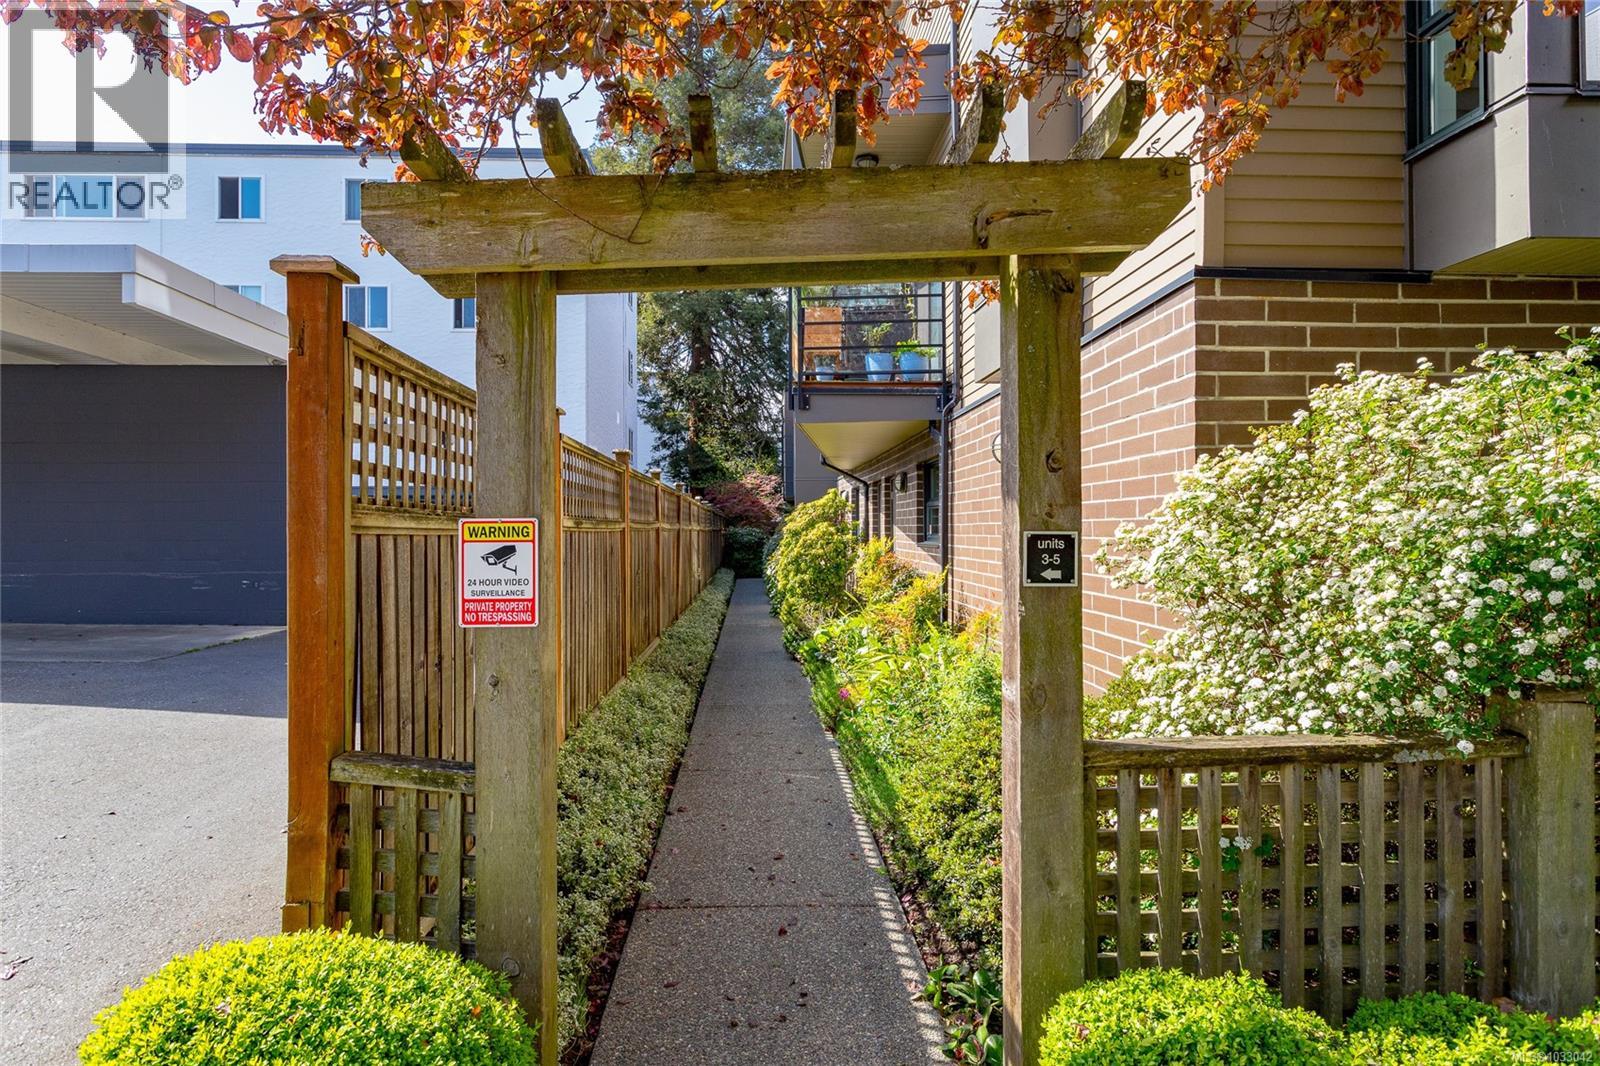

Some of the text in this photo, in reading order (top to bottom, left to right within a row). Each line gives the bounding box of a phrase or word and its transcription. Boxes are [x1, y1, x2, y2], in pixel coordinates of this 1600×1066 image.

[467, 525, 530, 538] WARNING
[1037, 537, 1065, 549] units
[1041, 553, 1061, 565] 3-5
[467, 578, 530, 587] 24 HOUR VIDEO
[470, 589, 526, 597] SURVEILLANCE
[464, 601, 532, 612] PRIVATE PROPERTY
[464, 612, 532, 622] NO TRESPASSING
